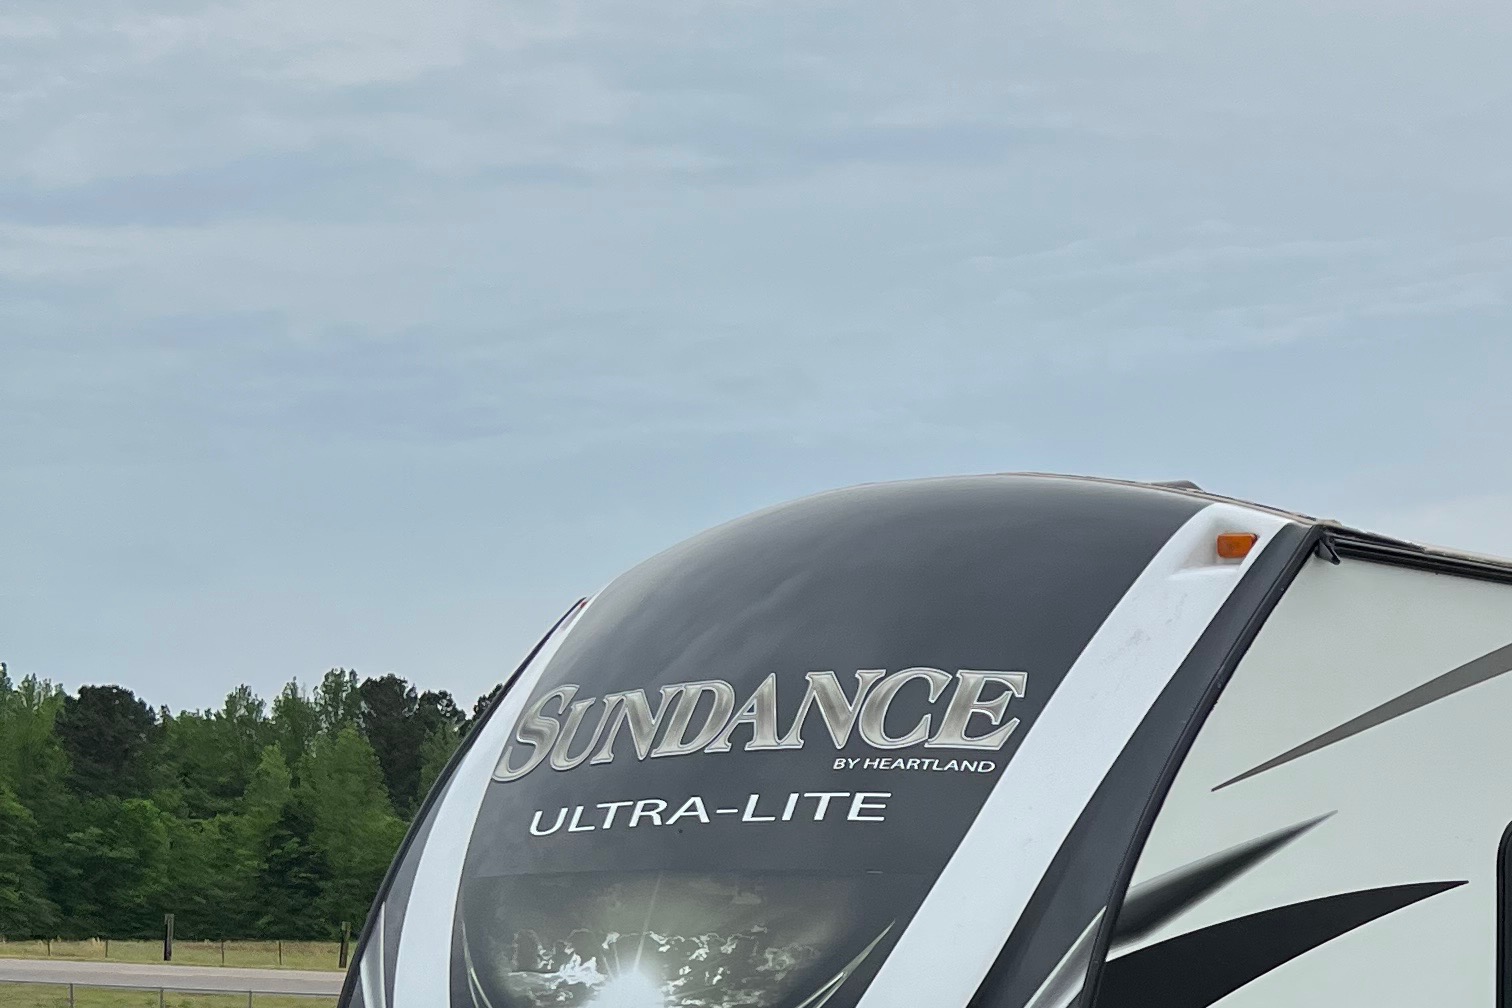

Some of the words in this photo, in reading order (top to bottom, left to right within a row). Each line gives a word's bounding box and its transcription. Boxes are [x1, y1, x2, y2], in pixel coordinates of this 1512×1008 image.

[491, 666, 1028, 782] SUNDANCE
[833, 757, 861, 770] BY
[863, 757, 996, 773] HEARTLAND
[529, 792, 892, 836] ULTRA-LITE
